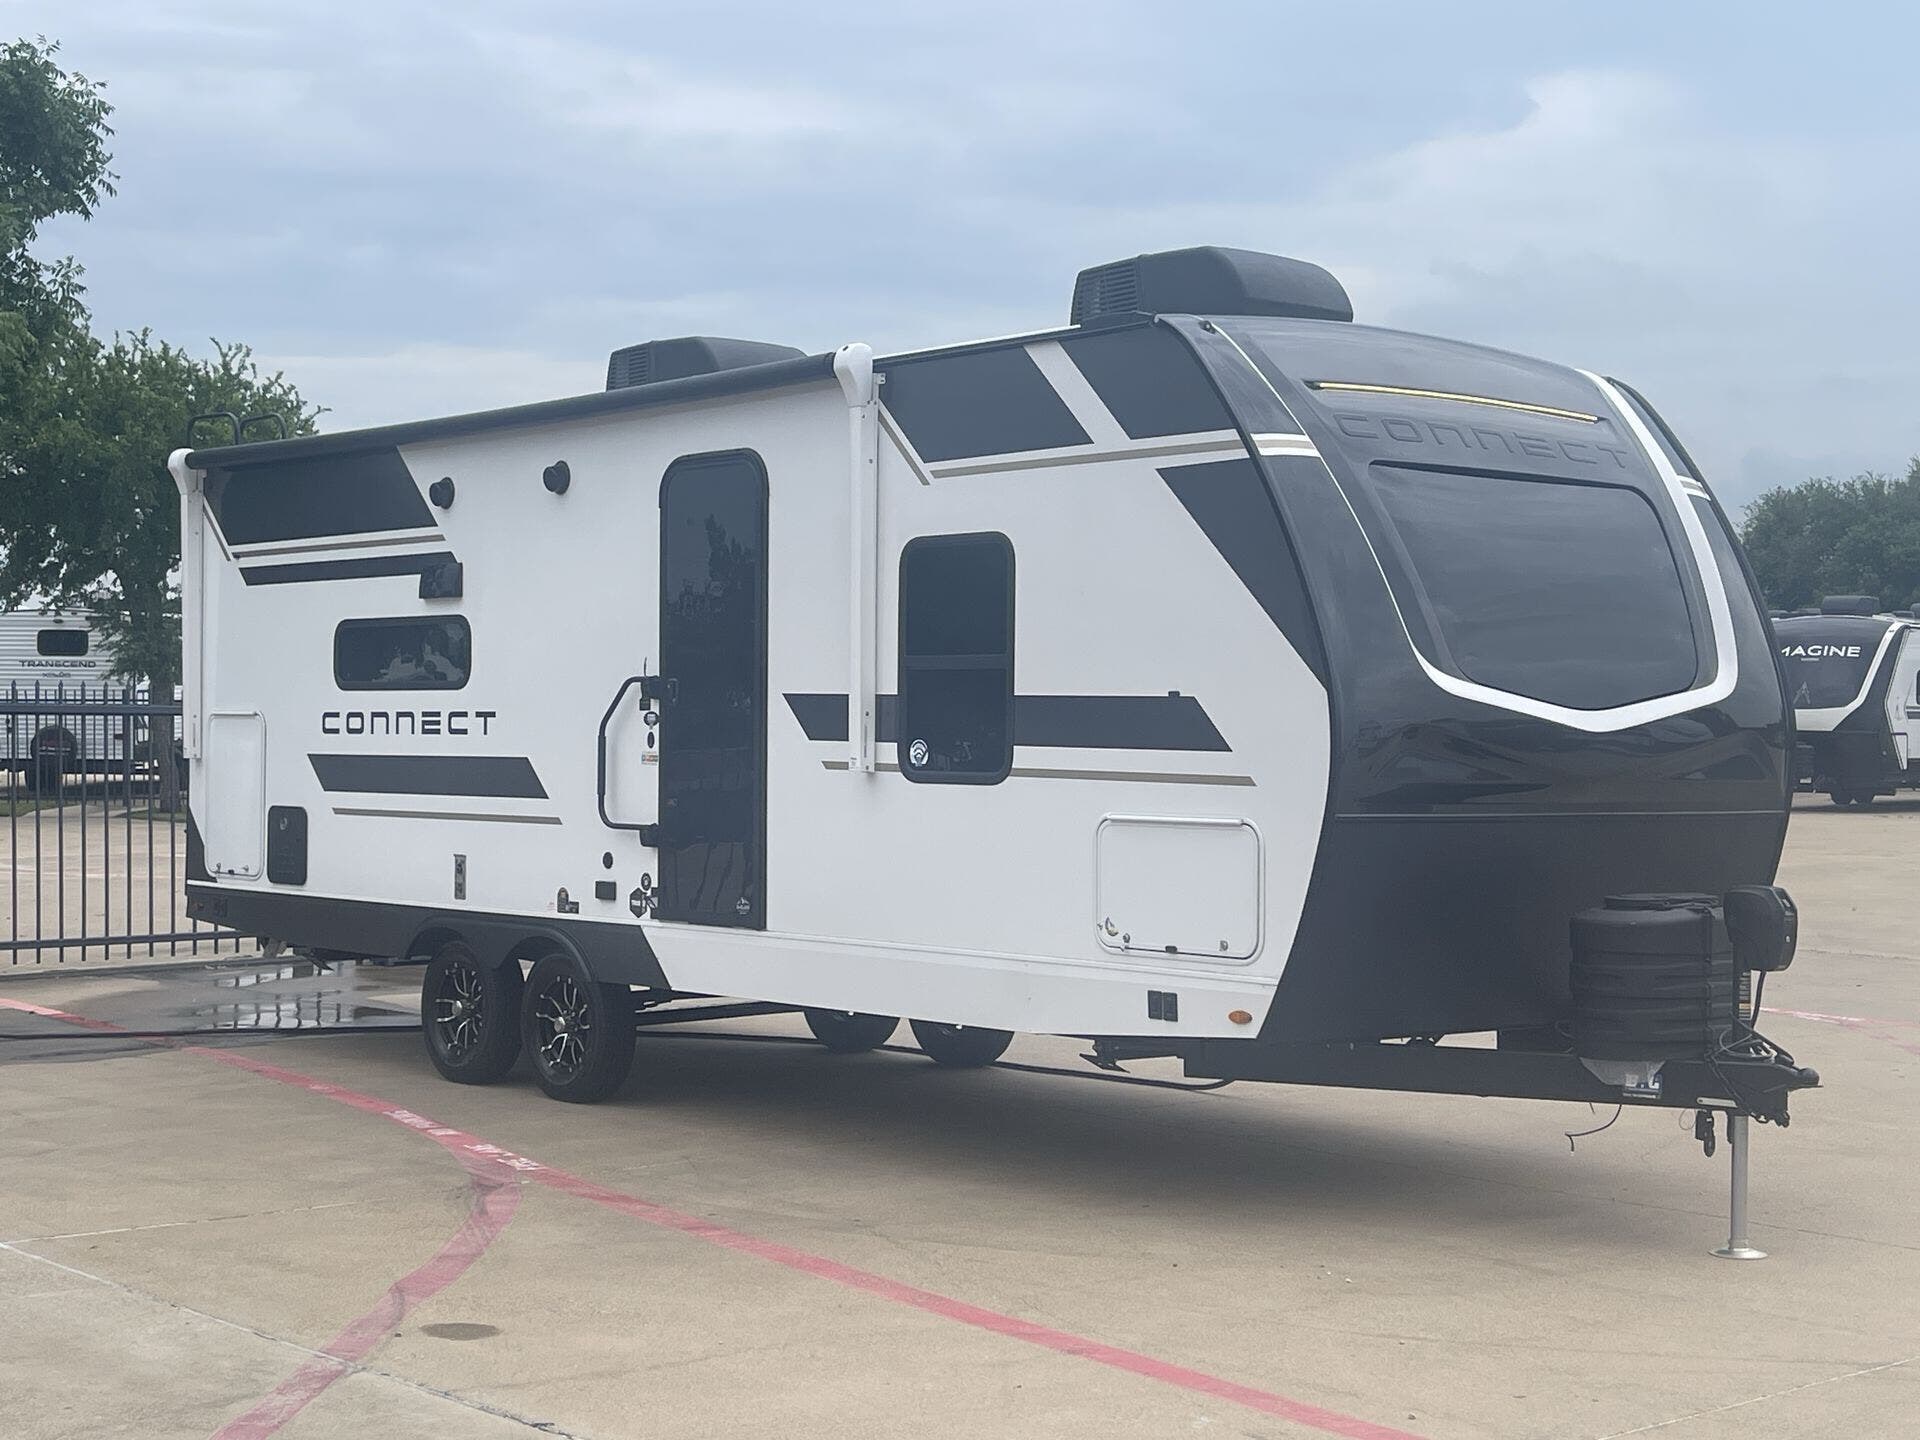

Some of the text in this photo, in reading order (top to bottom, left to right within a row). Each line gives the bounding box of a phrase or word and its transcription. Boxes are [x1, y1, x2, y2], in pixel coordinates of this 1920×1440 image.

[1332, 412, 1628, 468] CONNECT
[19, 660, 97, 668] TRANSCEND
[322, 711, 496, 735] CONNECT
